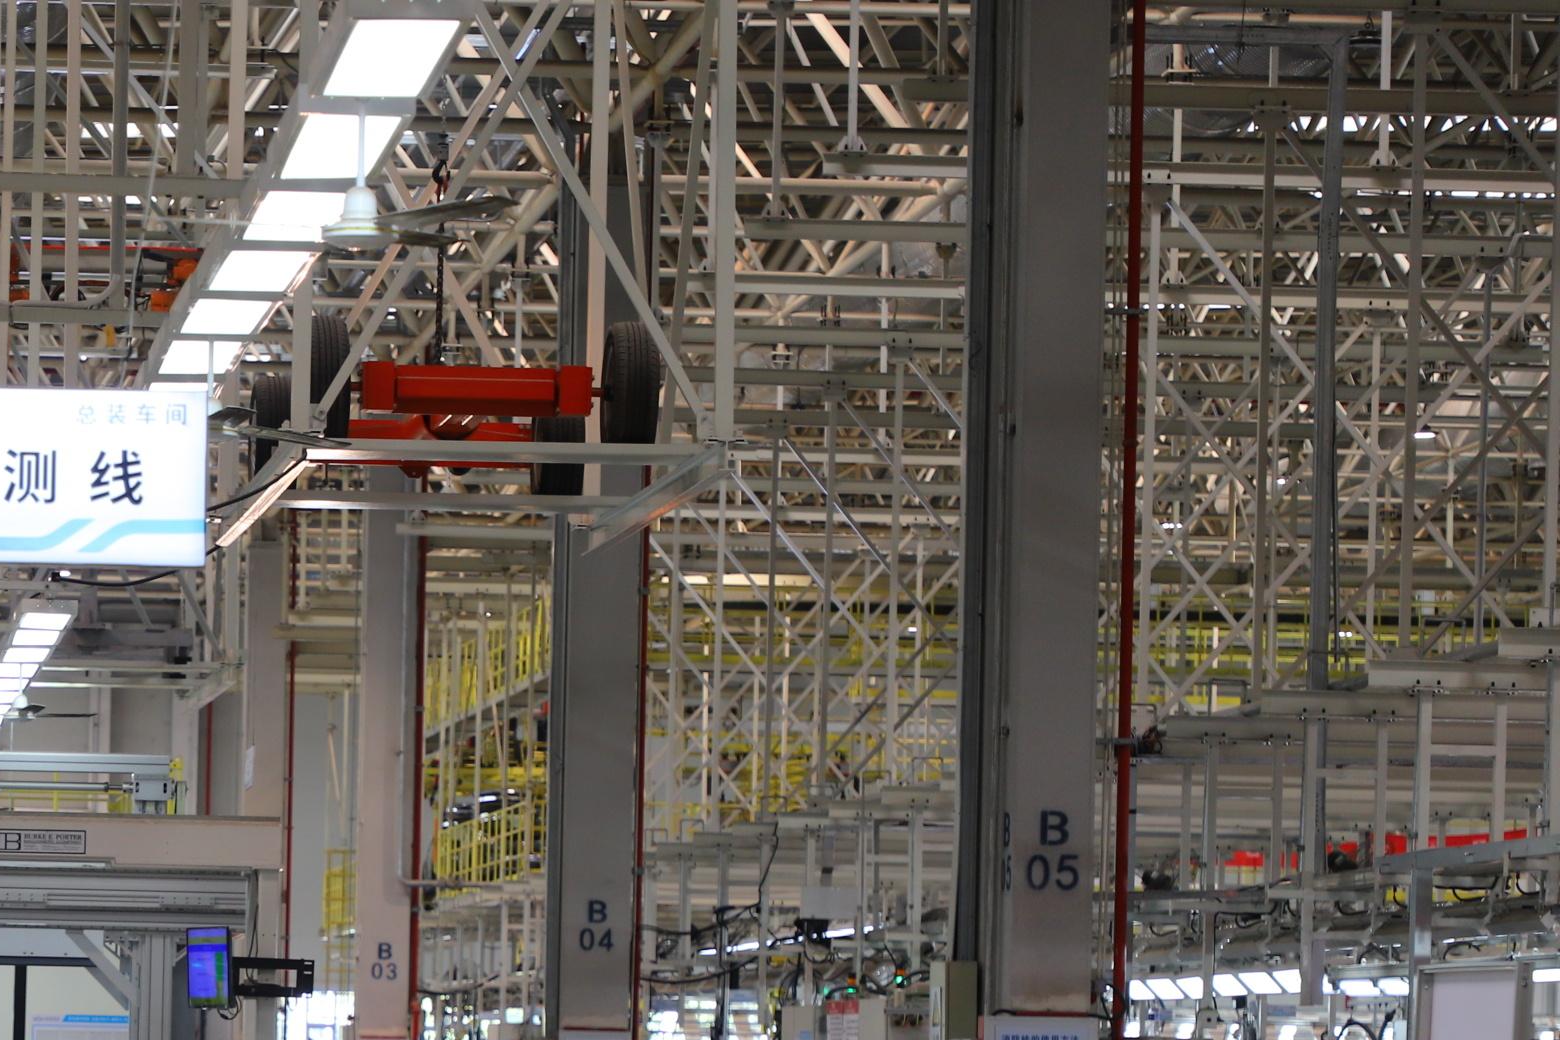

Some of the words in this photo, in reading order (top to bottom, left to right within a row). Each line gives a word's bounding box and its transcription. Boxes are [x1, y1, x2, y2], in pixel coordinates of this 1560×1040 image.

[76, 403, 188, 426] 总装车间
[1040, 810, 1070, 846] B
[1026, 853, 1080, 891] 05
[588, 900, 607, 923] B
[378, 942, 392, 960] B
[579, 928, 614, 952] 04
[371, 962, 398, 981] 03
